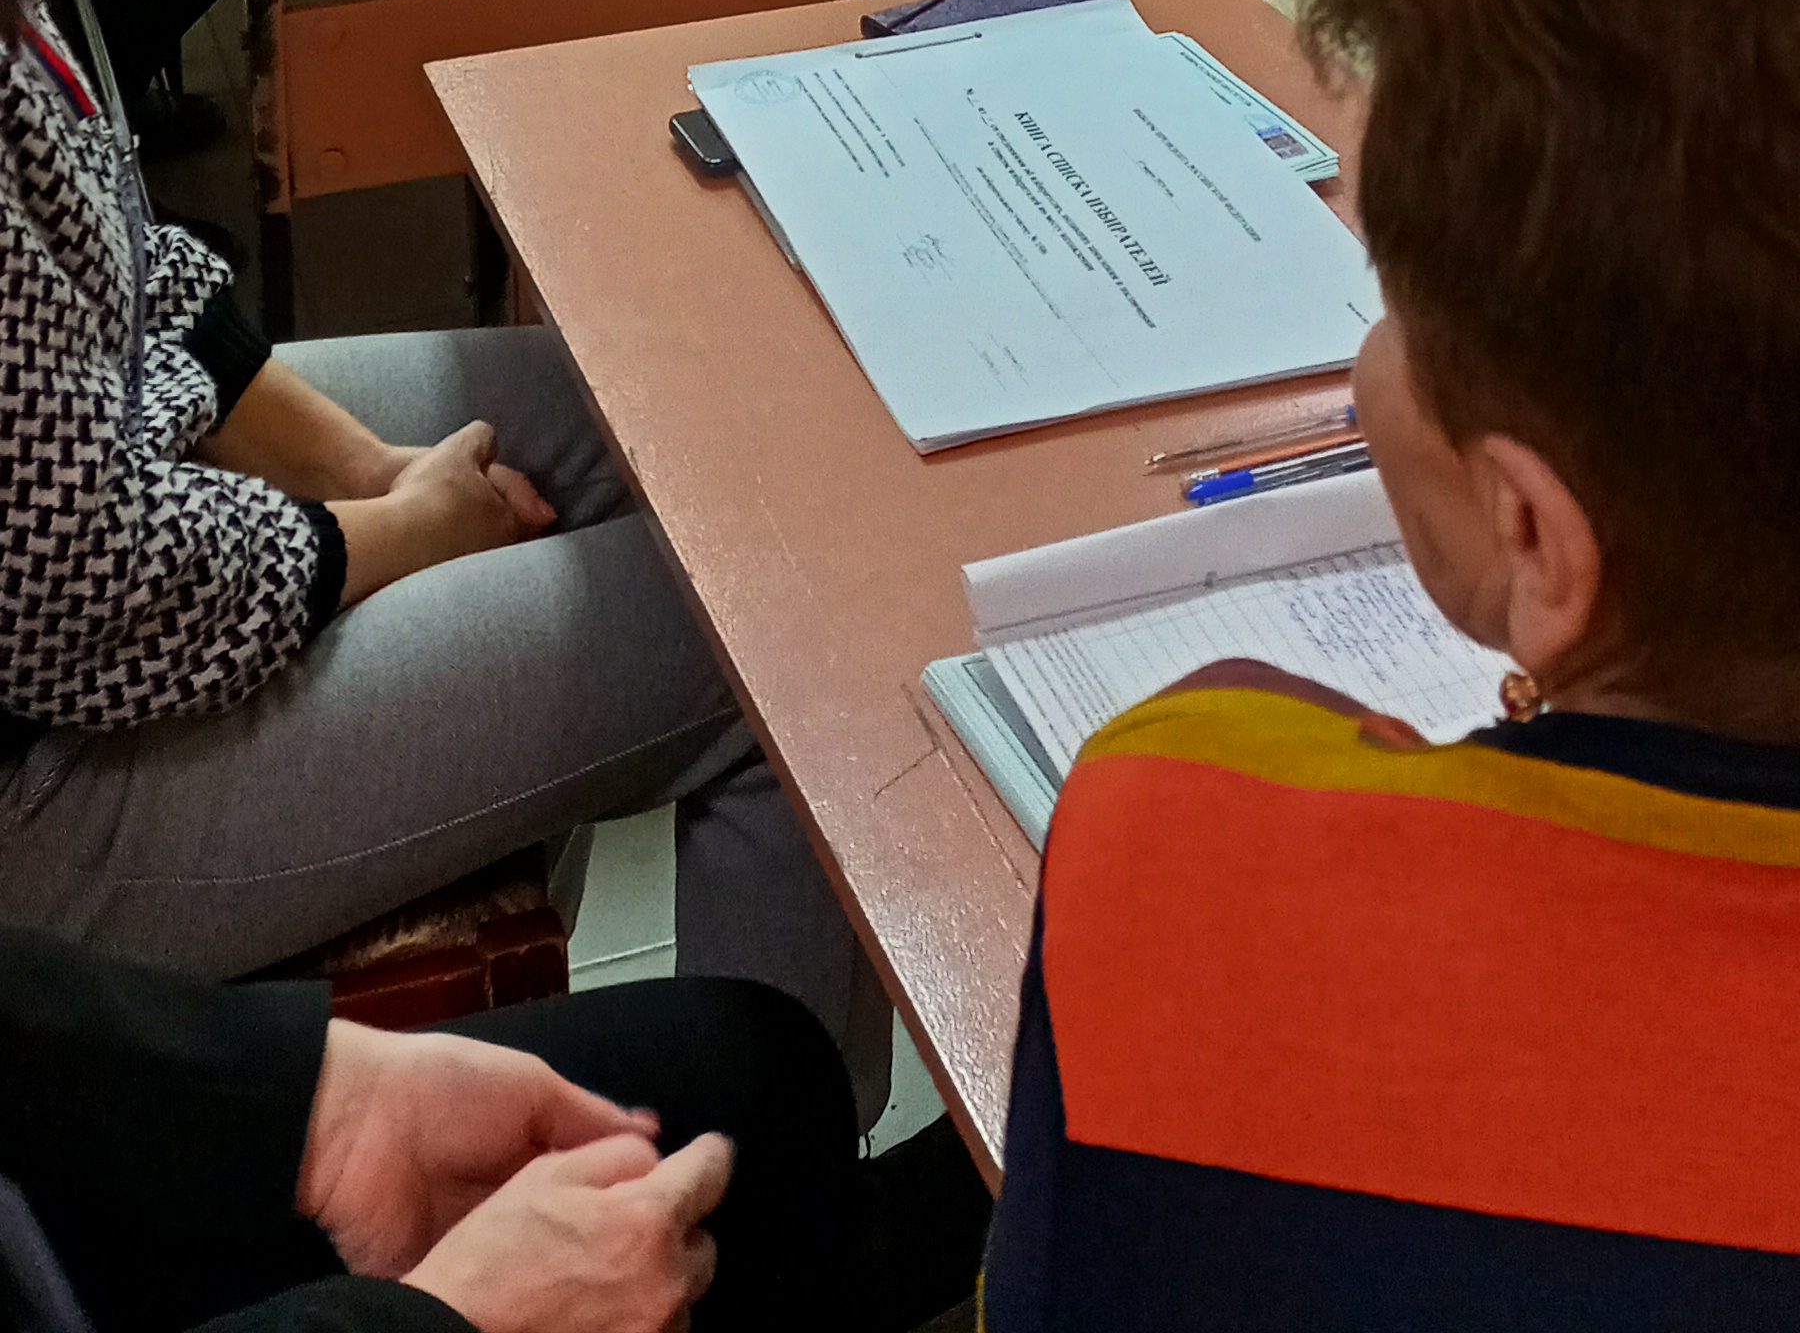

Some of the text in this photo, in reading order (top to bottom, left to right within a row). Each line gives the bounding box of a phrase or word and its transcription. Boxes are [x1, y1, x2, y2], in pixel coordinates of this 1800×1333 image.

[1014, 111, 1053, 152] КНИГА
[1046, 151, 1093, 199] СПИСКА
[1085, 196, 1173, 287] ИЗБИРАТЕЛЕЙ
